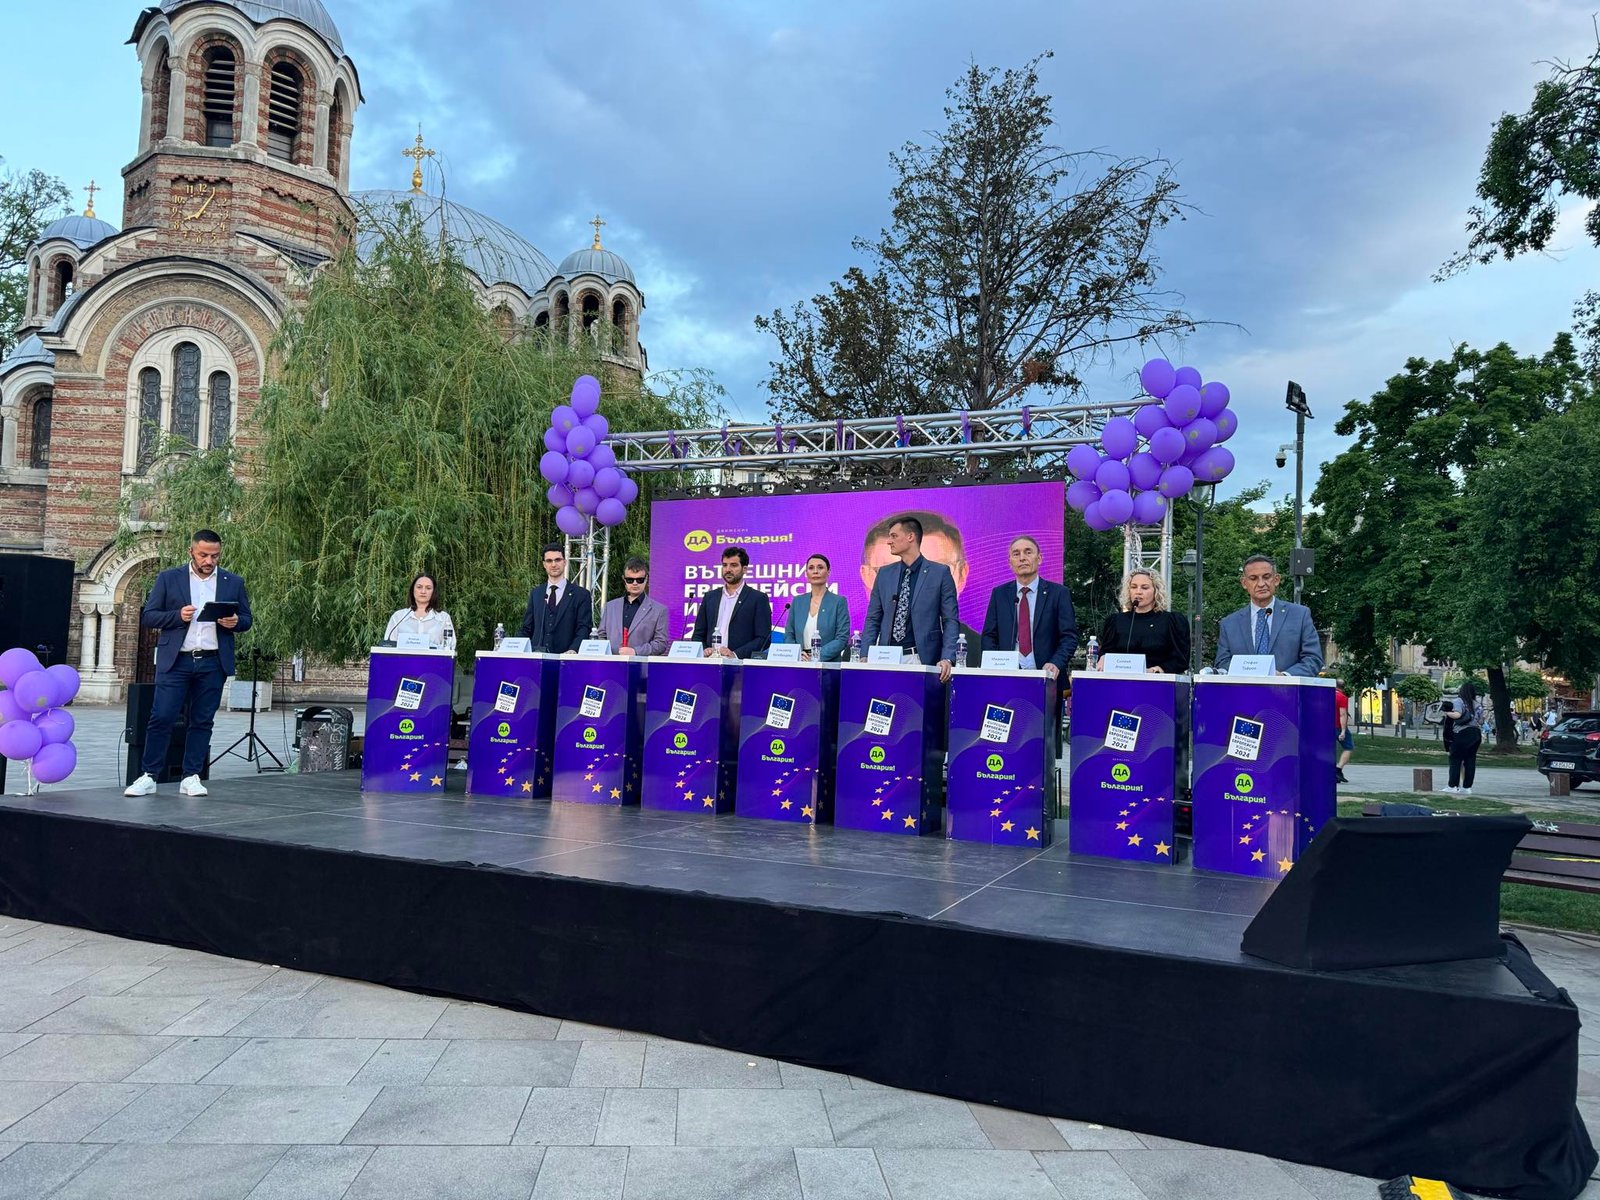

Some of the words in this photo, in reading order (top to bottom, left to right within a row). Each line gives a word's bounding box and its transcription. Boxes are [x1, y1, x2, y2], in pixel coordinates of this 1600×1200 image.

[198, 183, 207, 192] 12
[687, 535, 710, 546] ДА
[715, 533, 793, 545] България!
[685, 563, 808, 580] ВЪТЕШНИ
[400, 722, 413, 730] ДА
[870, 726, 884, 734] 2024
[584, 731, 596, 739] ДА
[986, 732, 1002, 740] 2024
[490, 736, 518, 744] България!
[675, 736, 688, 744] ДА
[1112, 740, 1128, 749] 2024
[576, 742, 604, 750] България!
[772, 742, 784, 751] ДА
[666, 748, 696, 756] България!
[870, 750, 884, 758] ДА
[1234, 748, 1250, 758] 2024
[762, 754, 794, 764] България!
[988, 758, 1002, 766] ДА
[860, 762, 896, 772] България!
[976, 770, 1016, 780] България!
[1114, 768, 1128, 777] ДА
[1100, 782, 1144, 792] България!
[1236, 778, 1252, 787] ДА
[1224, 792, 1266, 804] България!
